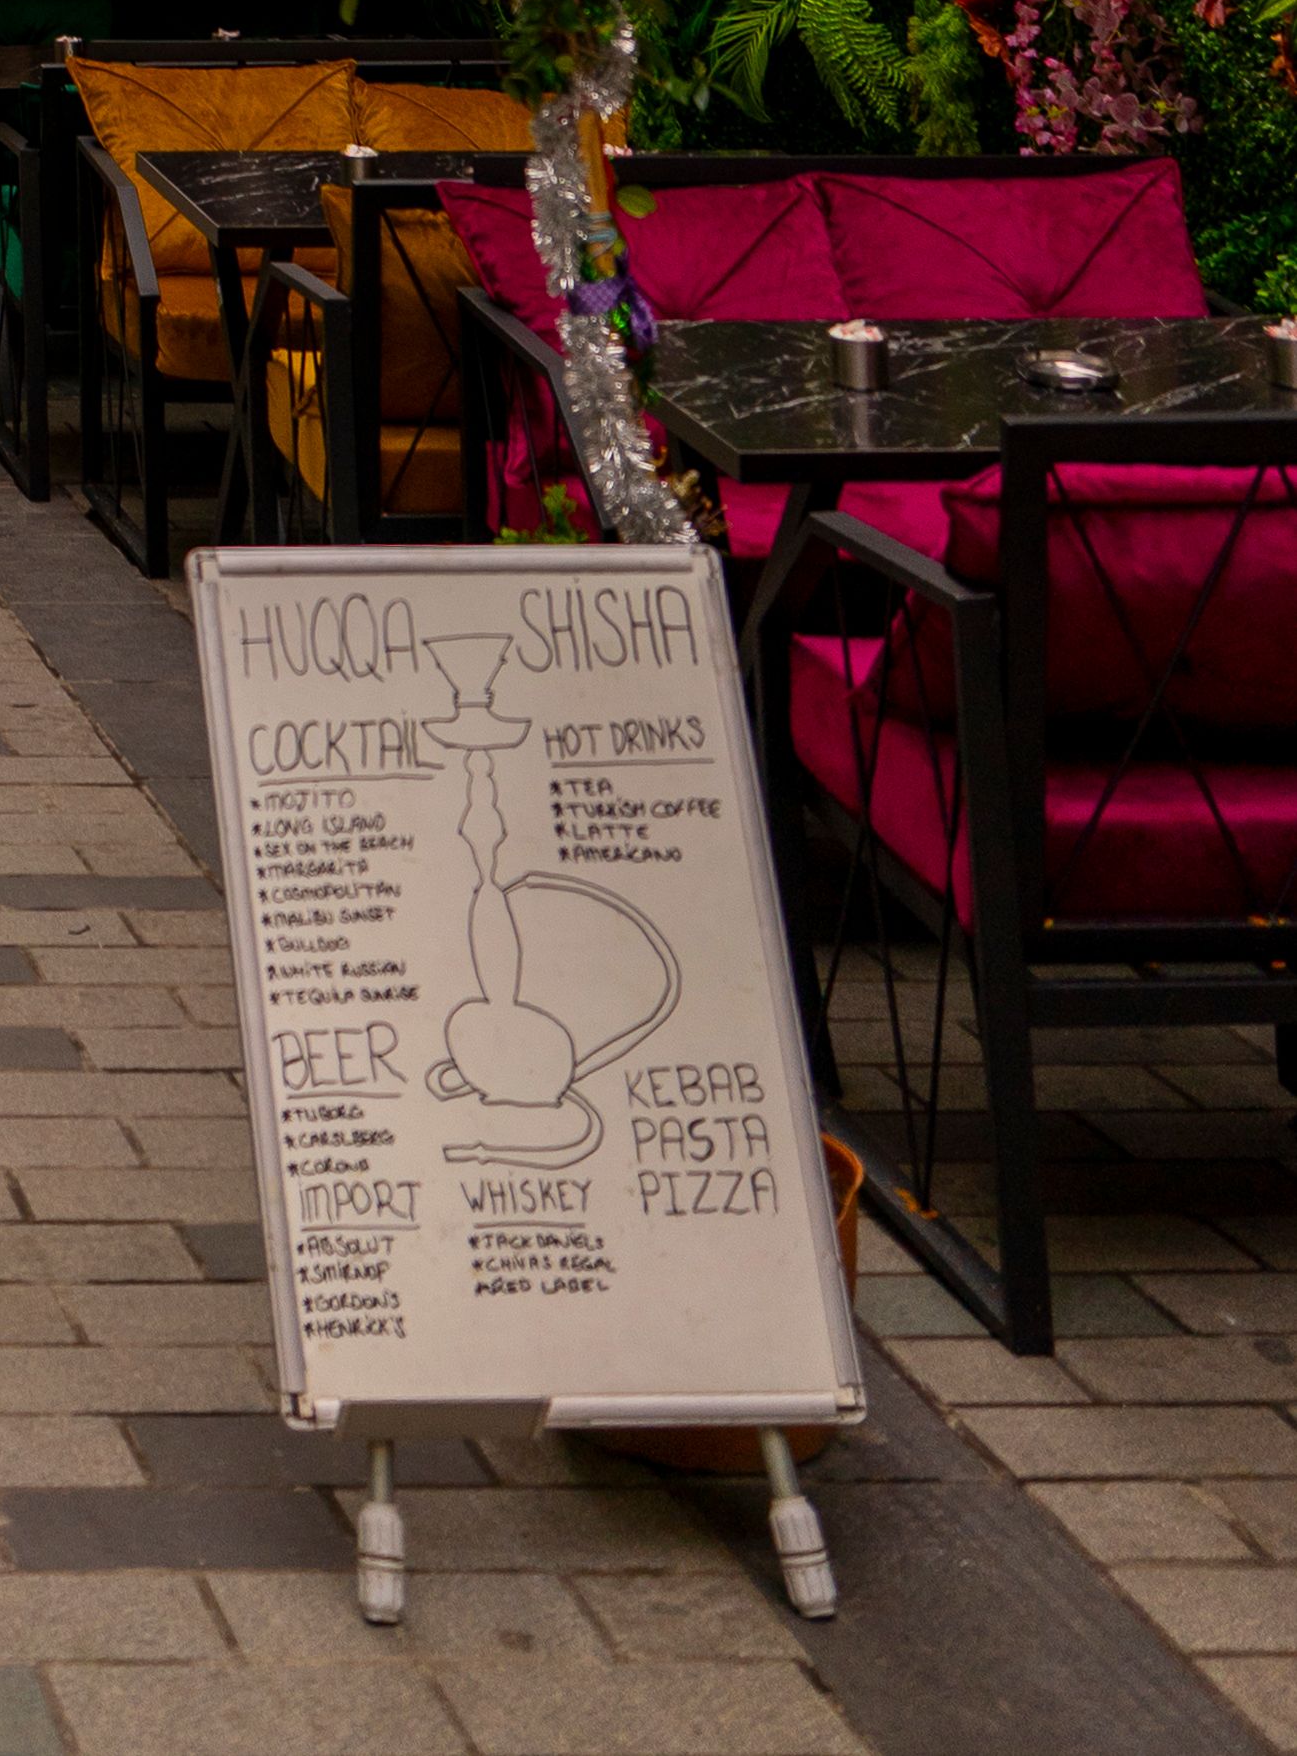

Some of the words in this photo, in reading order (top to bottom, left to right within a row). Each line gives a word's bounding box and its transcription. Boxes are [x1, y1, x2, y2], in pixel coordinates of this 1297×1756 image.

[240, 593, 419, 684] HUQQA
[543, 723, 603, 760] HOT
[609, 715, 707, 755] DRINKS
[565, 777, 613, 797] TEA
[650, 796, 722, 819] COFFEE
[265, 816, 315, 838] LONG
[573, 823, 650, 841] LATTE
[265, 840, 291, 858] SEX
[296, 840, 317, 856] ON
[320, 838, 352, 854] THE
[359, 833, 415, 852] BEACH
[272, 1020, 408, 1091] BEER
[624, 1062, 765, 1109] KEBAB
[295, 1105, 363, 1122] TUBORG
[632, 1113, 770, 1164] PASTA
[637, 1166, 779, 1217] PIZZA
[307, 1235, 395, 1258] ABSOLUT
[484, 1232, 531, 1250] JACK
[541, 1276, 610, 1295] LABEL
